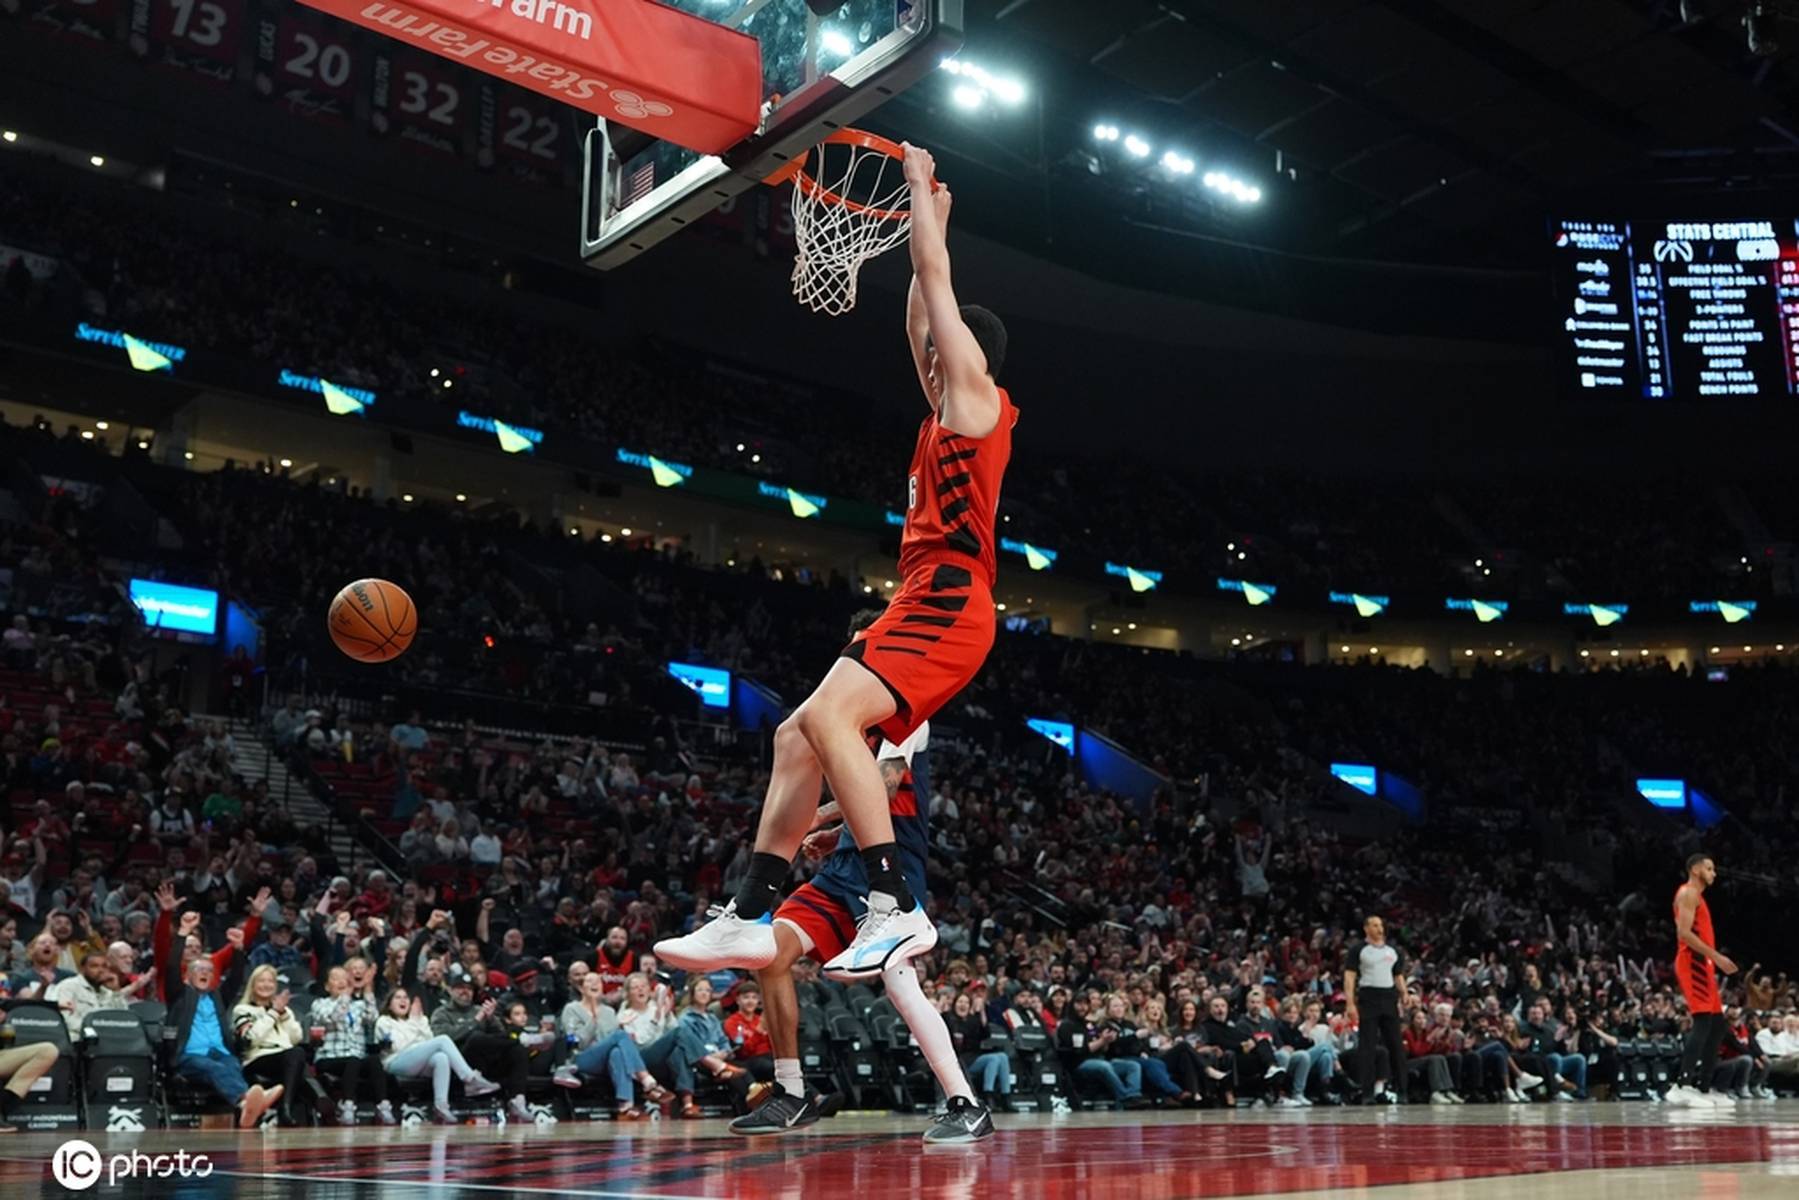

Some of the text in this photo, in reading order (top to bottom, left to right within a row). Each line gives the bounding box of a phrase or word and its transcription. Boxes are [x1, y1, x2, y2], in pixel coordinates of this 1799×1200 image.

[168, 0, 228, 47] 13
[285, 32, 351, 88] 20
[399, 72, 460, 127] 32
[504, 106, 560, 160] 22
[1666, 222, 1775, 241] STATS CENTRAL
[908, 476, 916, 510] 6
